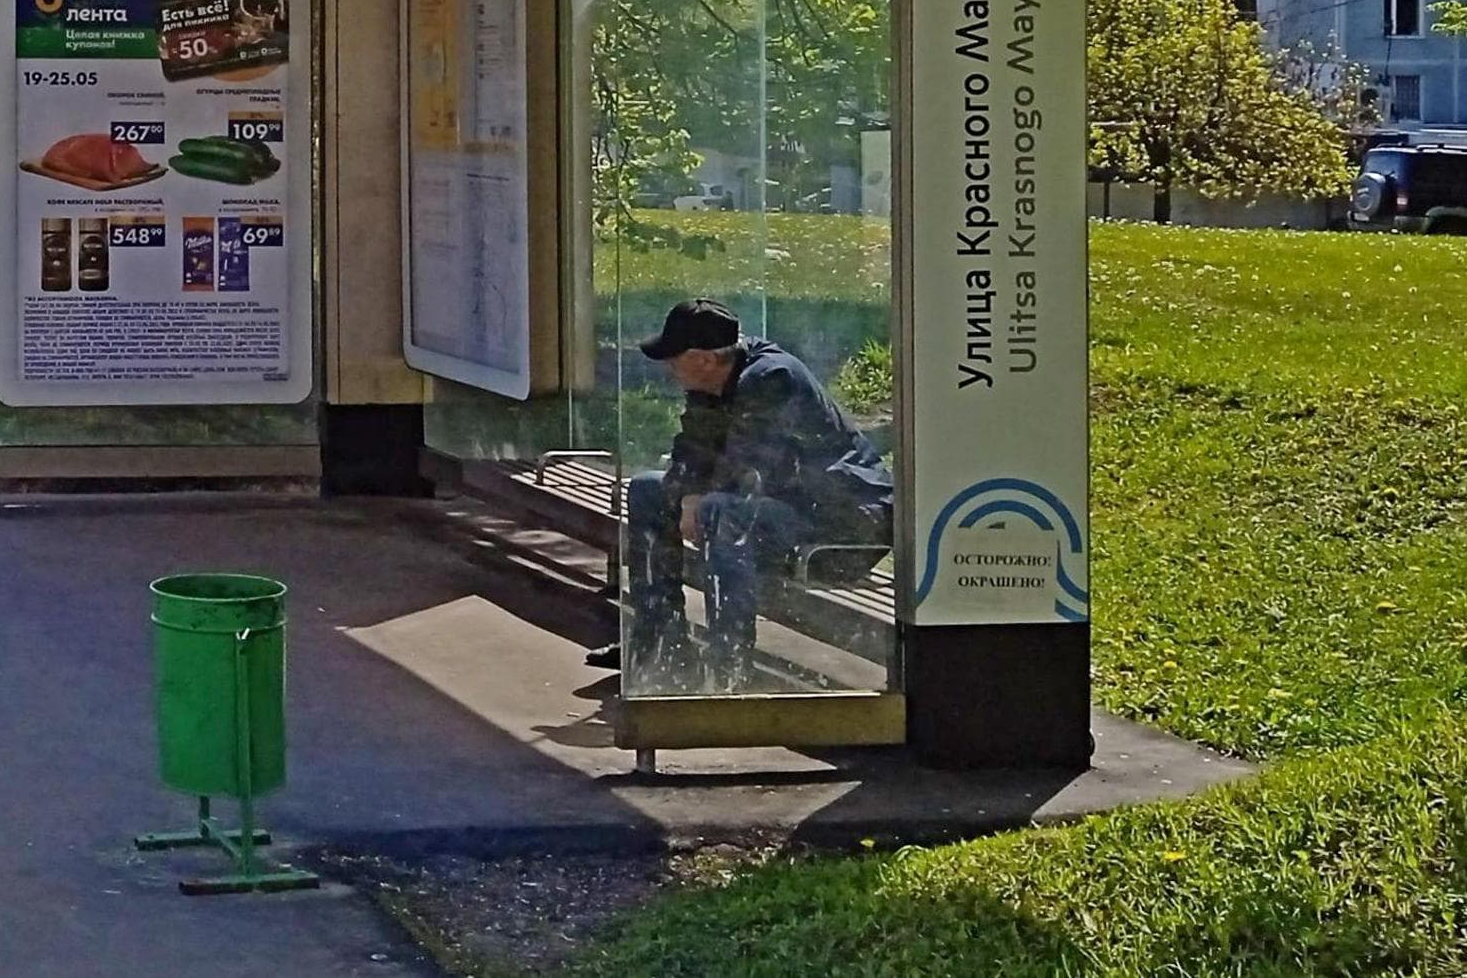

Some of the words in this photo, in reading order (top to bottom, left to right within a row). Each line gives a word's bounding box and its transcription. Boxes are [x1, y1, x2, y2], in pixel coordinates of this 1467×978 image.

[66, 7, 127, 22] лента
[162, 8, 194, 22] Есть
[197, 0, 229, 16] всё!
[66, 29, 101, 40] Целая
[103, 31, 145, 39] книжка
[66, 39, 115, 51] купонов!
[24, 72, 98, 85] 19-25.05
[956, 73, 999, 256] Красного
[1008, 85, 1042, 259] Krasnogo
[957, 269, 997, 389] Улица
[1008, 270, 1037, 373] Ulitsa
[953, 554, 1051, 567] ОСТОРОЖНО!
[958, 576, 1045, 588] ОКРАШЕНО!
